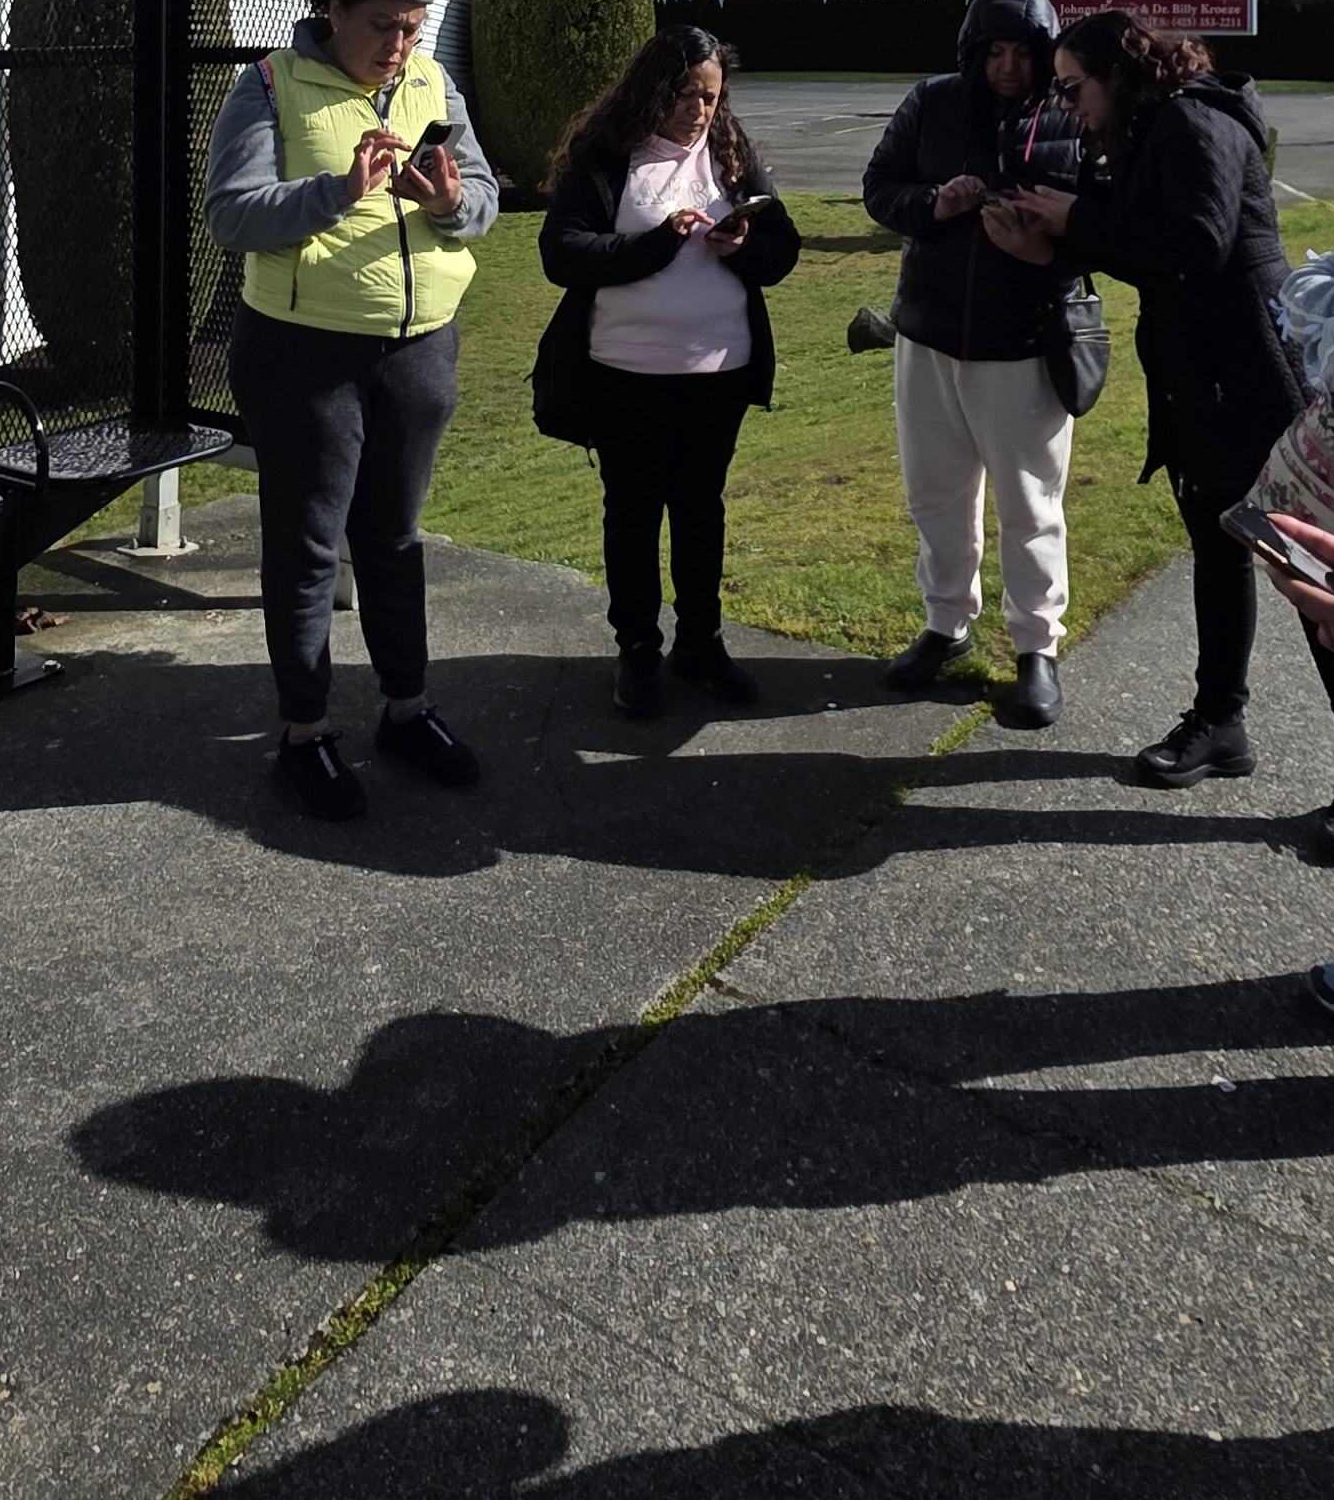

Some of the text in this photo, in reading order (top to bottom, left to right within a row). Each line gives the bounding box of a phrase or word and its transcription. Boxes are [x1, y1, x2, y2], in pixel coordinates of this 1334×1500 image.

[1140, 4, 1149, 14] &
[1152, 4, 1169, 14] Dr.
[1172, 4, 1198, 16] Billy
[1200, 4, 1241, 14] Kroeze
[1199, 17, 1241, 27] 353-2211
